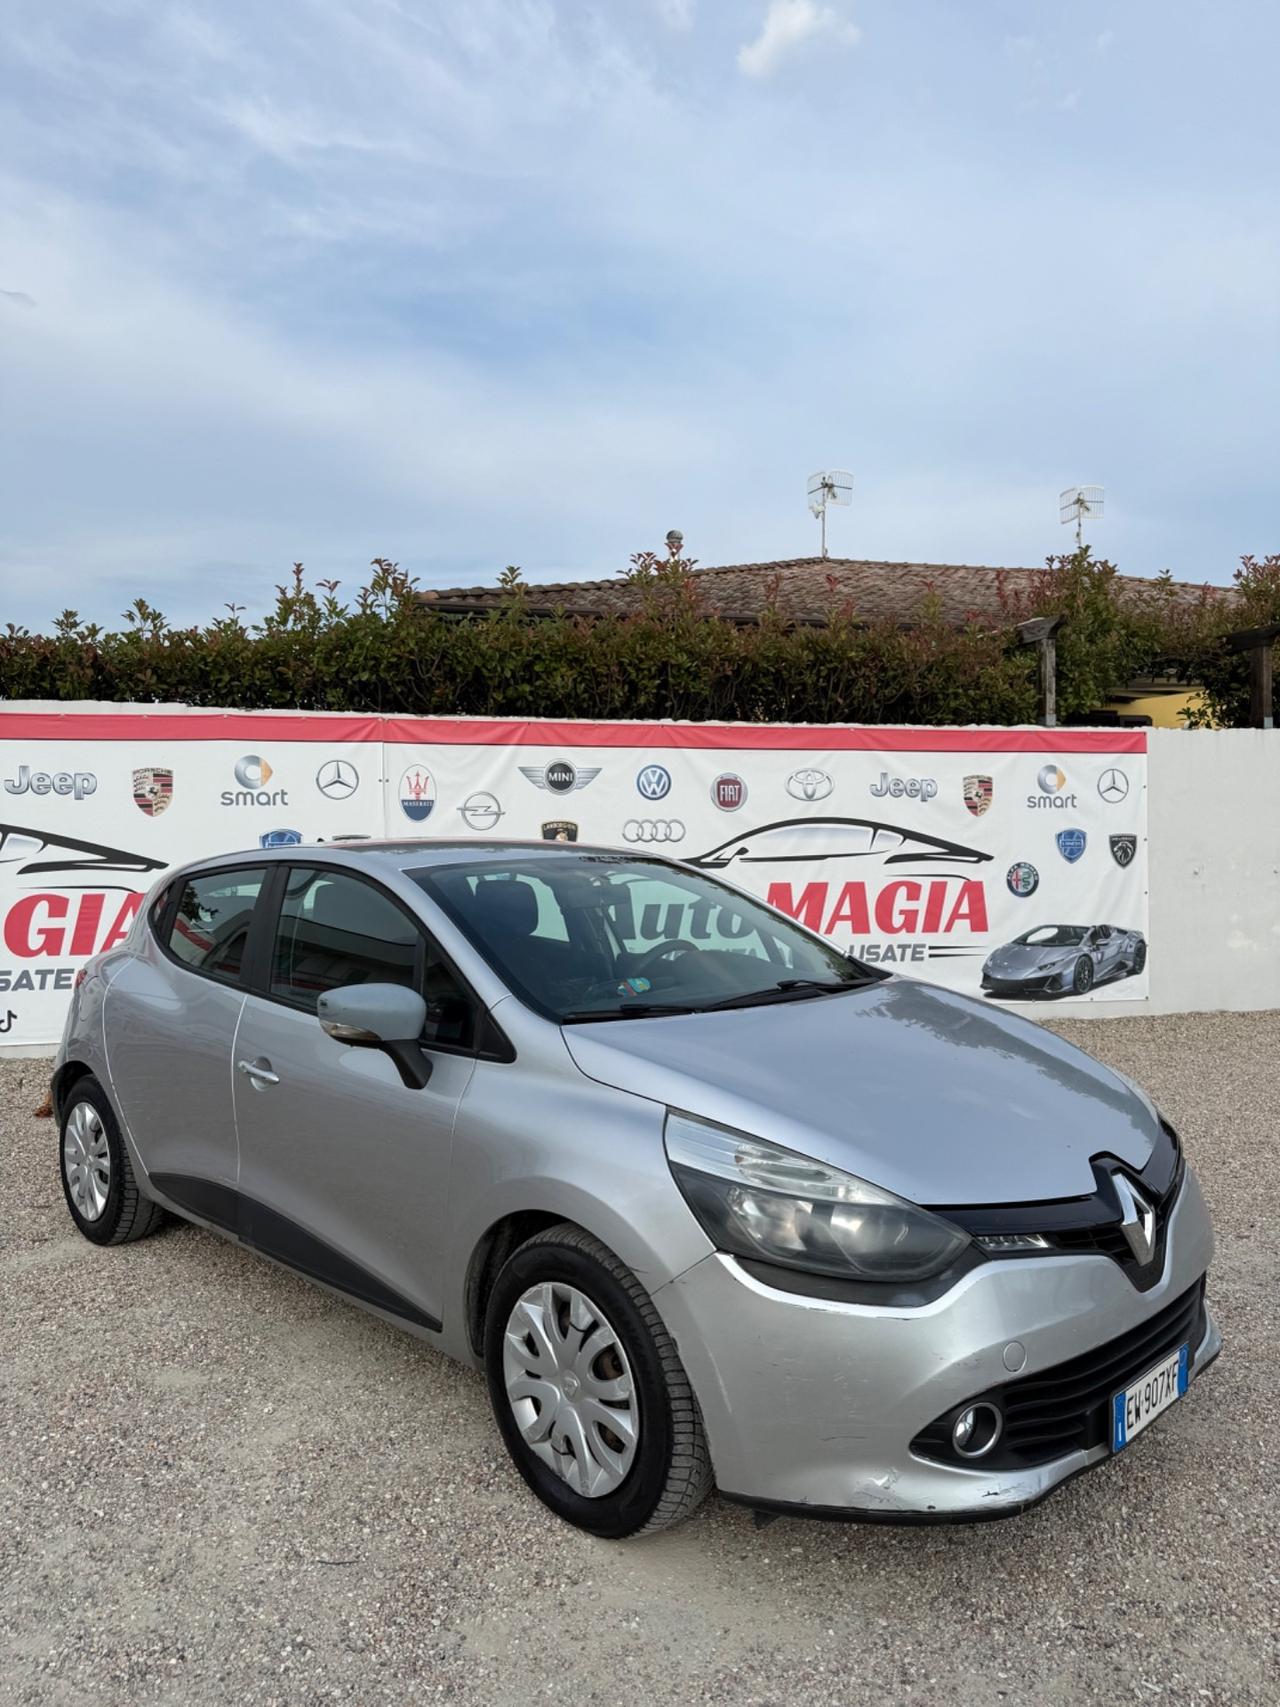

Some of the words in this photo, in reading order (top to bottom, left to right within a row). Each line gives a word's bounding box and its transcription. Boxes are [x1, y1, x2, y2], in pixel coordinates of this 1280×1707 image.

[4, 765, 97, 800] Jeep
[548, 772, 574, 782] MINI
[720, 785, 740, 802] FIAT
[869, 772, 938, 802] Jeep
[220, 788, 289, 807] smart
[1027, 793, 1077, 809] smart
[767, 880, 989, 934] MAGIA
